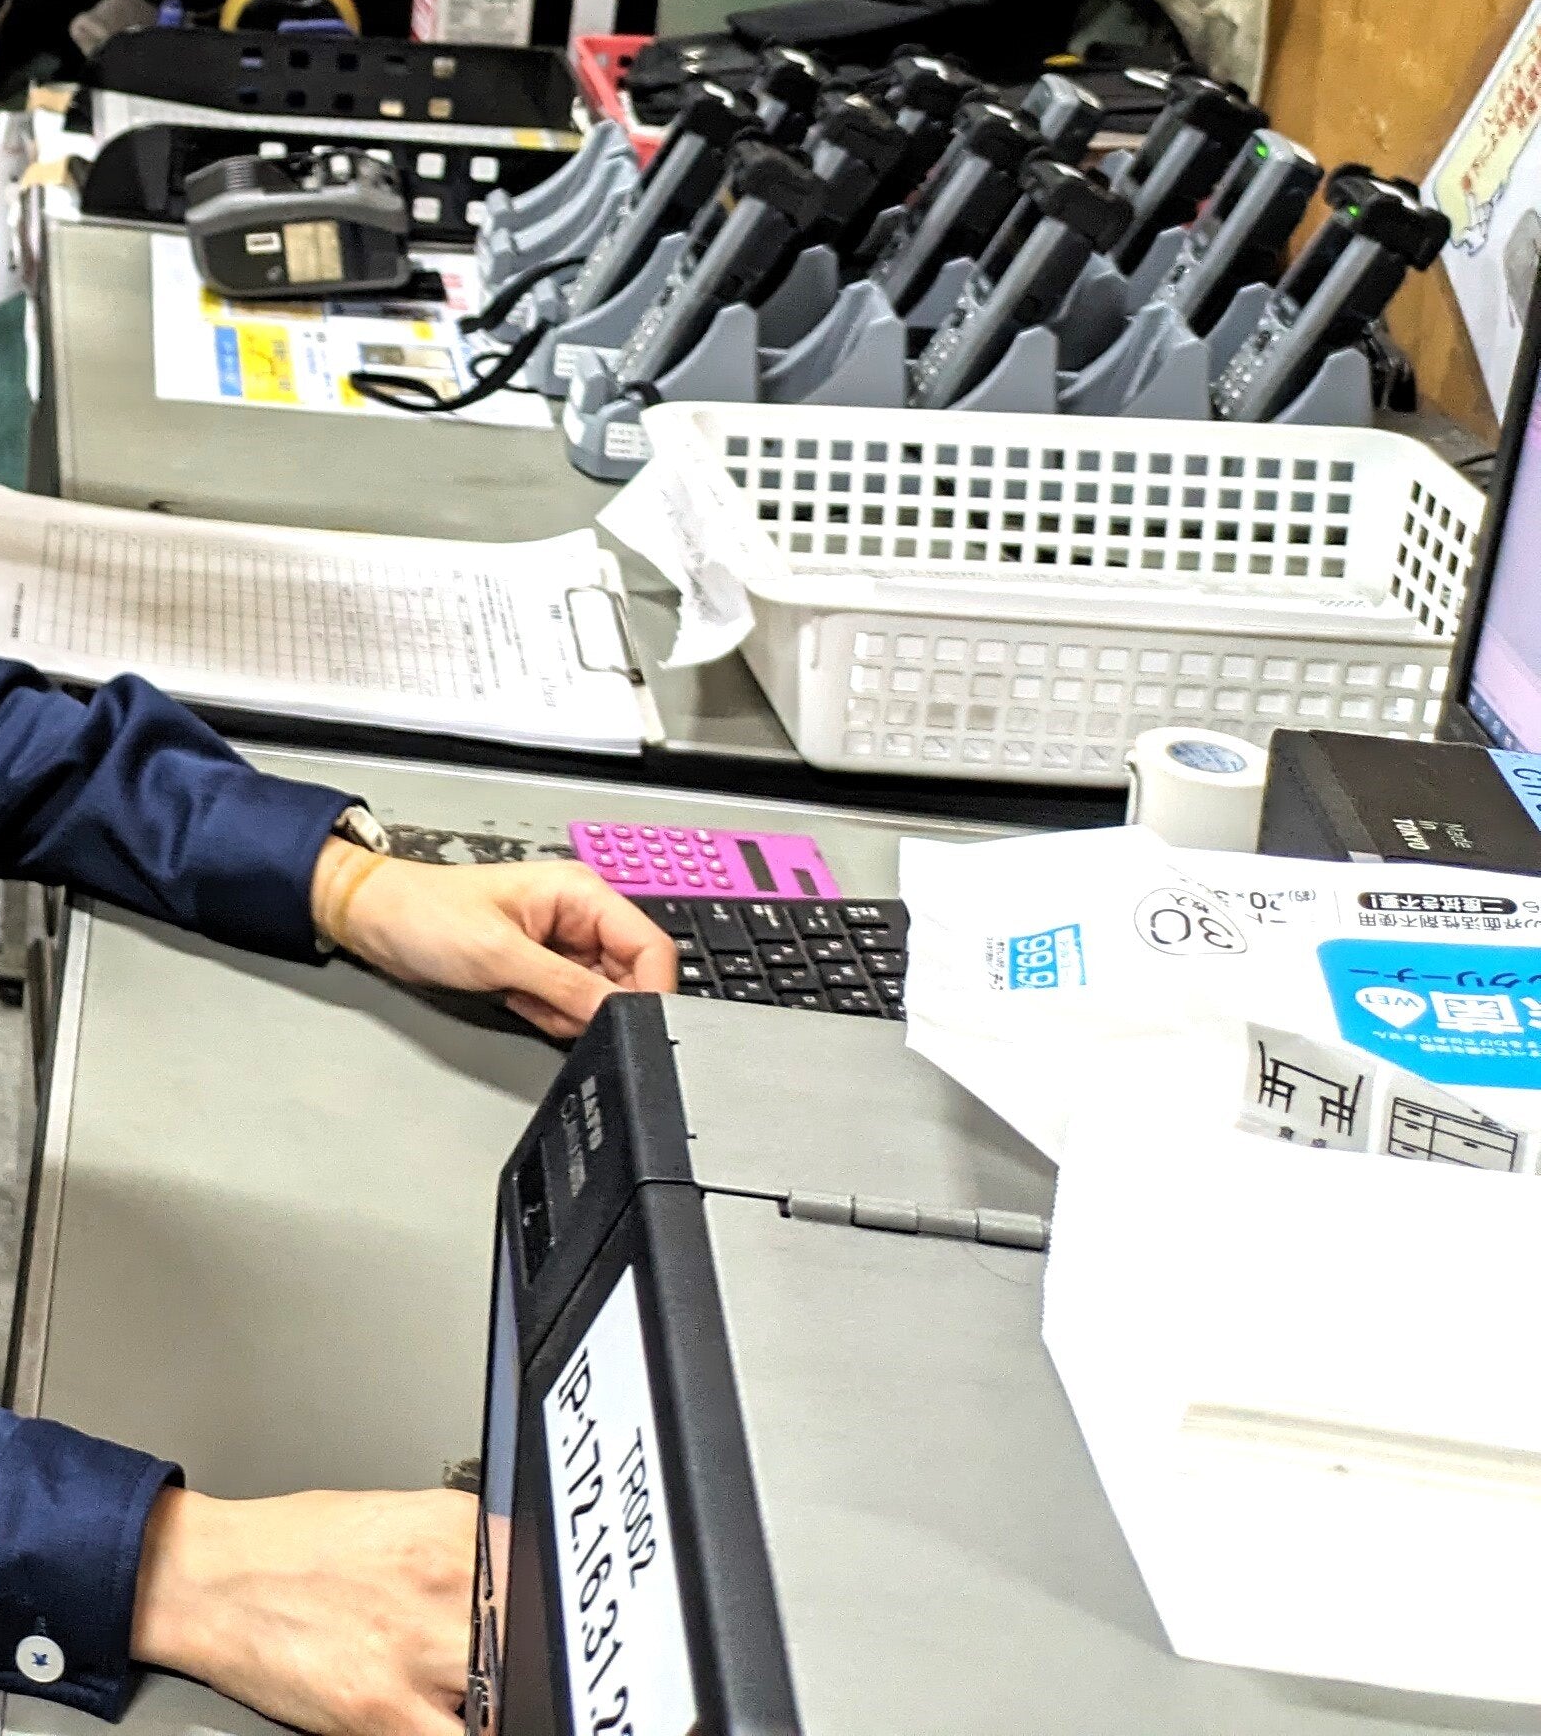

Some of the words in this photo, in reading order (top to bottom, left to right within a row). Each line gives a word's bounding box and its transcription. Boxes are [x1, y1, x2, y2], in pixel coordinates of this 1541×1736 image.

[1392, 818, 1431, 851] TOKYO
[1418, 820, 1438, 831] in
[1442, 822, 1473, 849] Made
[1369, 893, 1504, 913] 二度拭き不要!
[1150, 907, 1234, 950] 30
[1364, 992, 1420, 1008] WET
[617, 1426, 657, 1590] TR002
